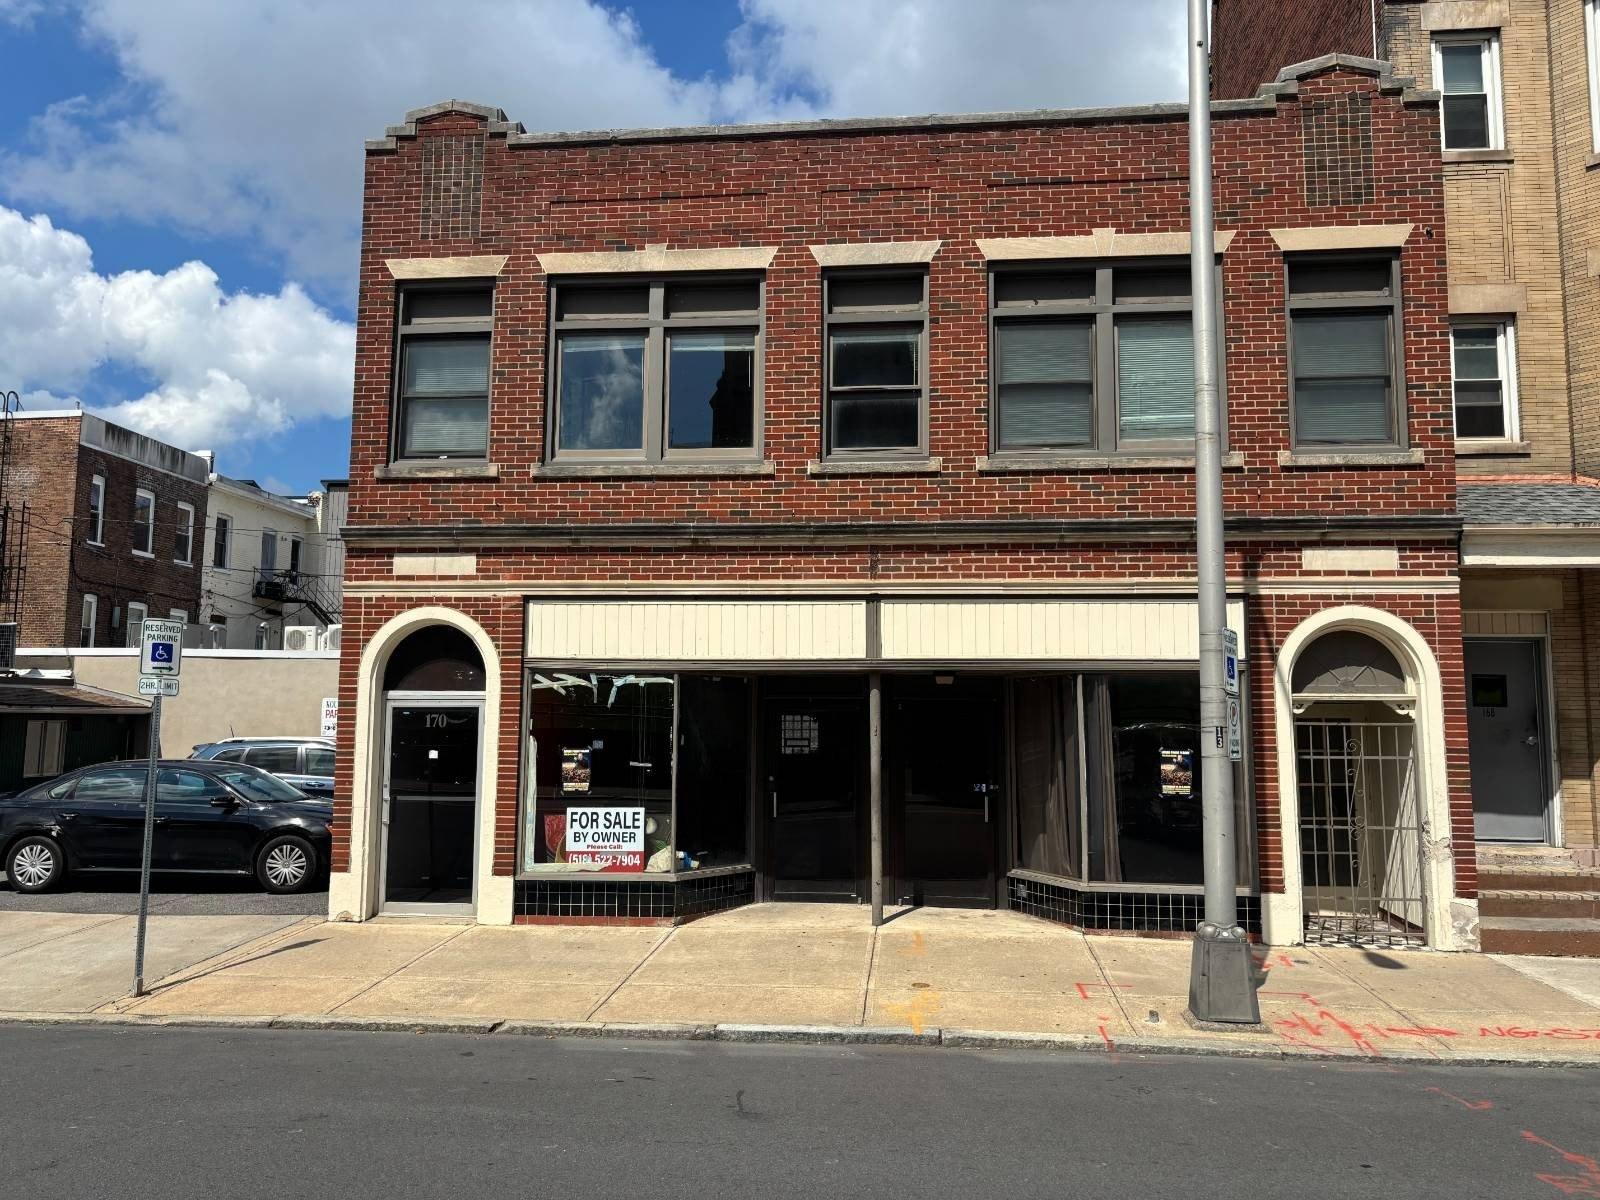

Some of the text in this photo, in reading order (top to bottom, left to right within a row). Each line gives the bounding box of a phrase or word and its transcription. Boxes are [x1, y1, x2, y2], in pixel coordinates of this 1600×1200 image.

[145, 624, 180, 634] RESERVED
[147, 634, 178, 642] PARKING
[160, 682, 177, 691] LIMIT
[425, 713, 447, 728] 170
[570, 811, 640, 829] FOR SALE
[573, 831, 636, 843] BY OWNER
[594, 854, 640, 866] 522-7904
